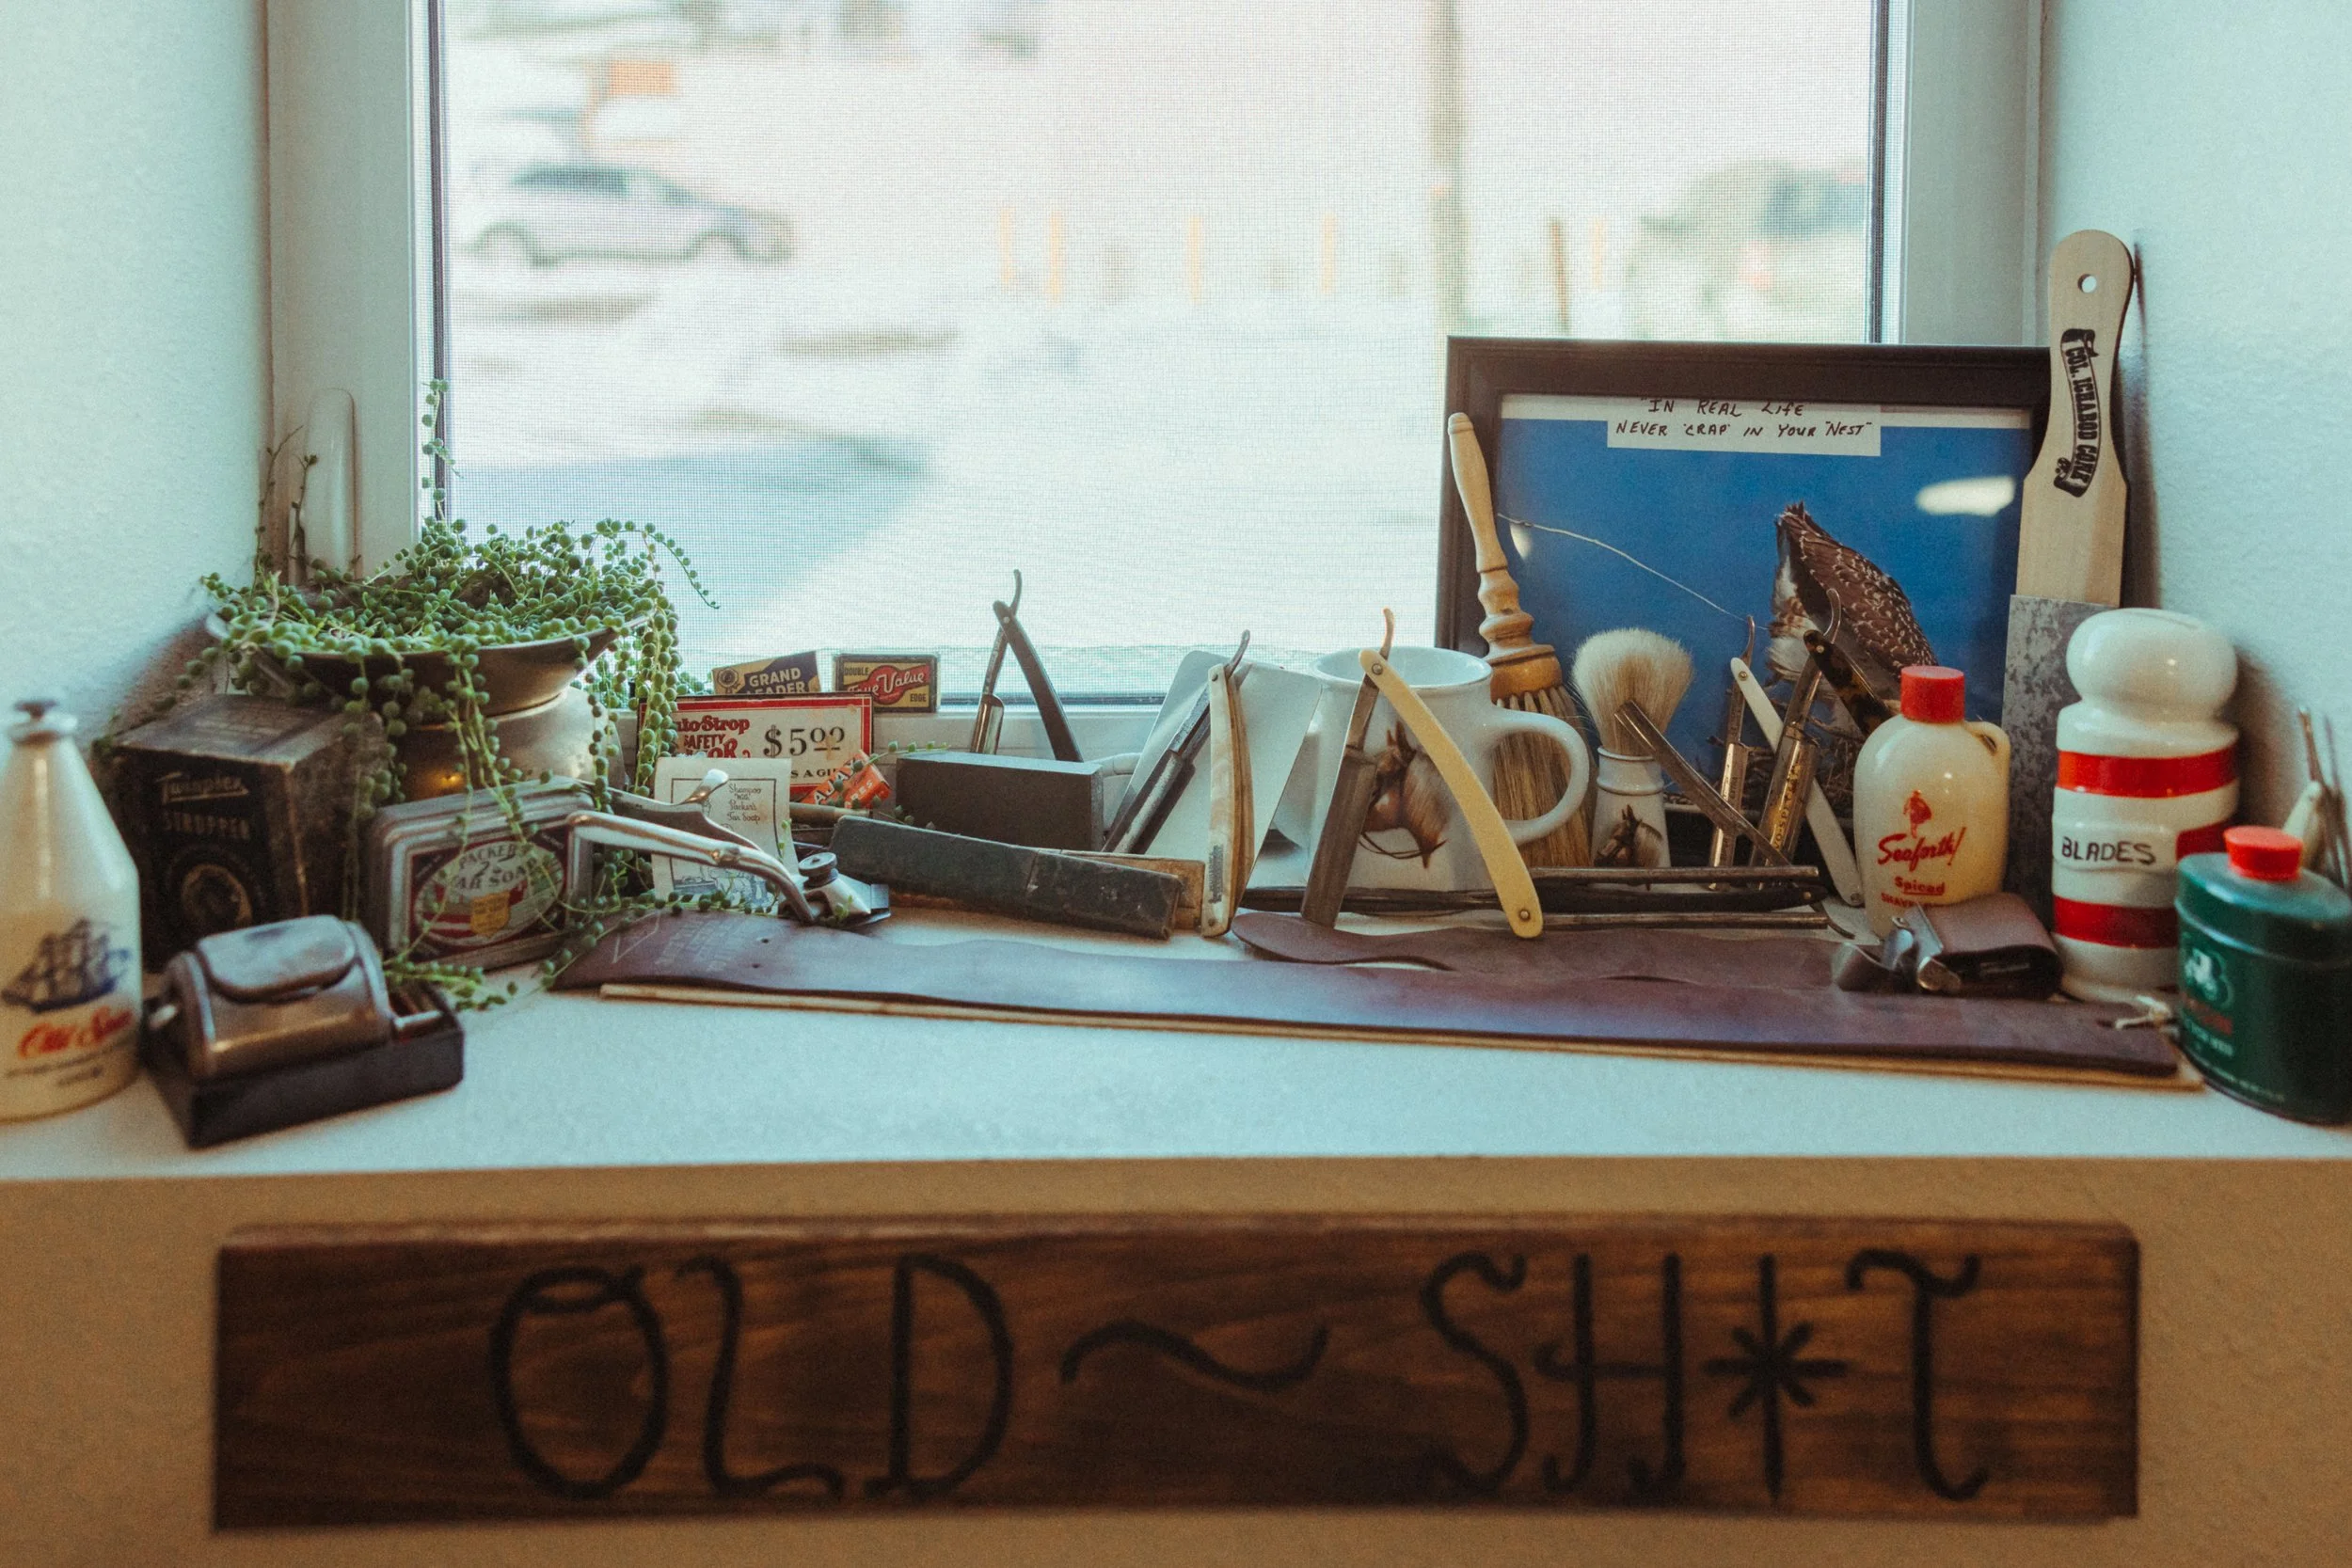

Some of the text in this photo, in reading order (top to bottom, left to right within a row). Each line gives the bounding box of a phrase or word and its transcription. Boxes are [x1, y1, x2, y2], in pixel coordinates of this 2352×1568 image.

[1696, 399, 1742, 418] REAL
[2065, 346, 2099, 483] COL. ICHABOD CONK
[1615, 420, 1668, 436] NEVER
[1742, 425, 1764, 437] IN
[749, 667, 801, 687] GRAND
[876, 671, 925, 693] Value
[746, 681, 806, 695] EADER
[910, 692, 927, 702] EDGE
[684, 734, 725, 749] SAFETY
[803, 768, 814, 778] A
[2061, 836, 2157, 864] BLADES
[1894, 876, 1946, 896] Spiced
[489, 1253, 1014, 1502] OLD
